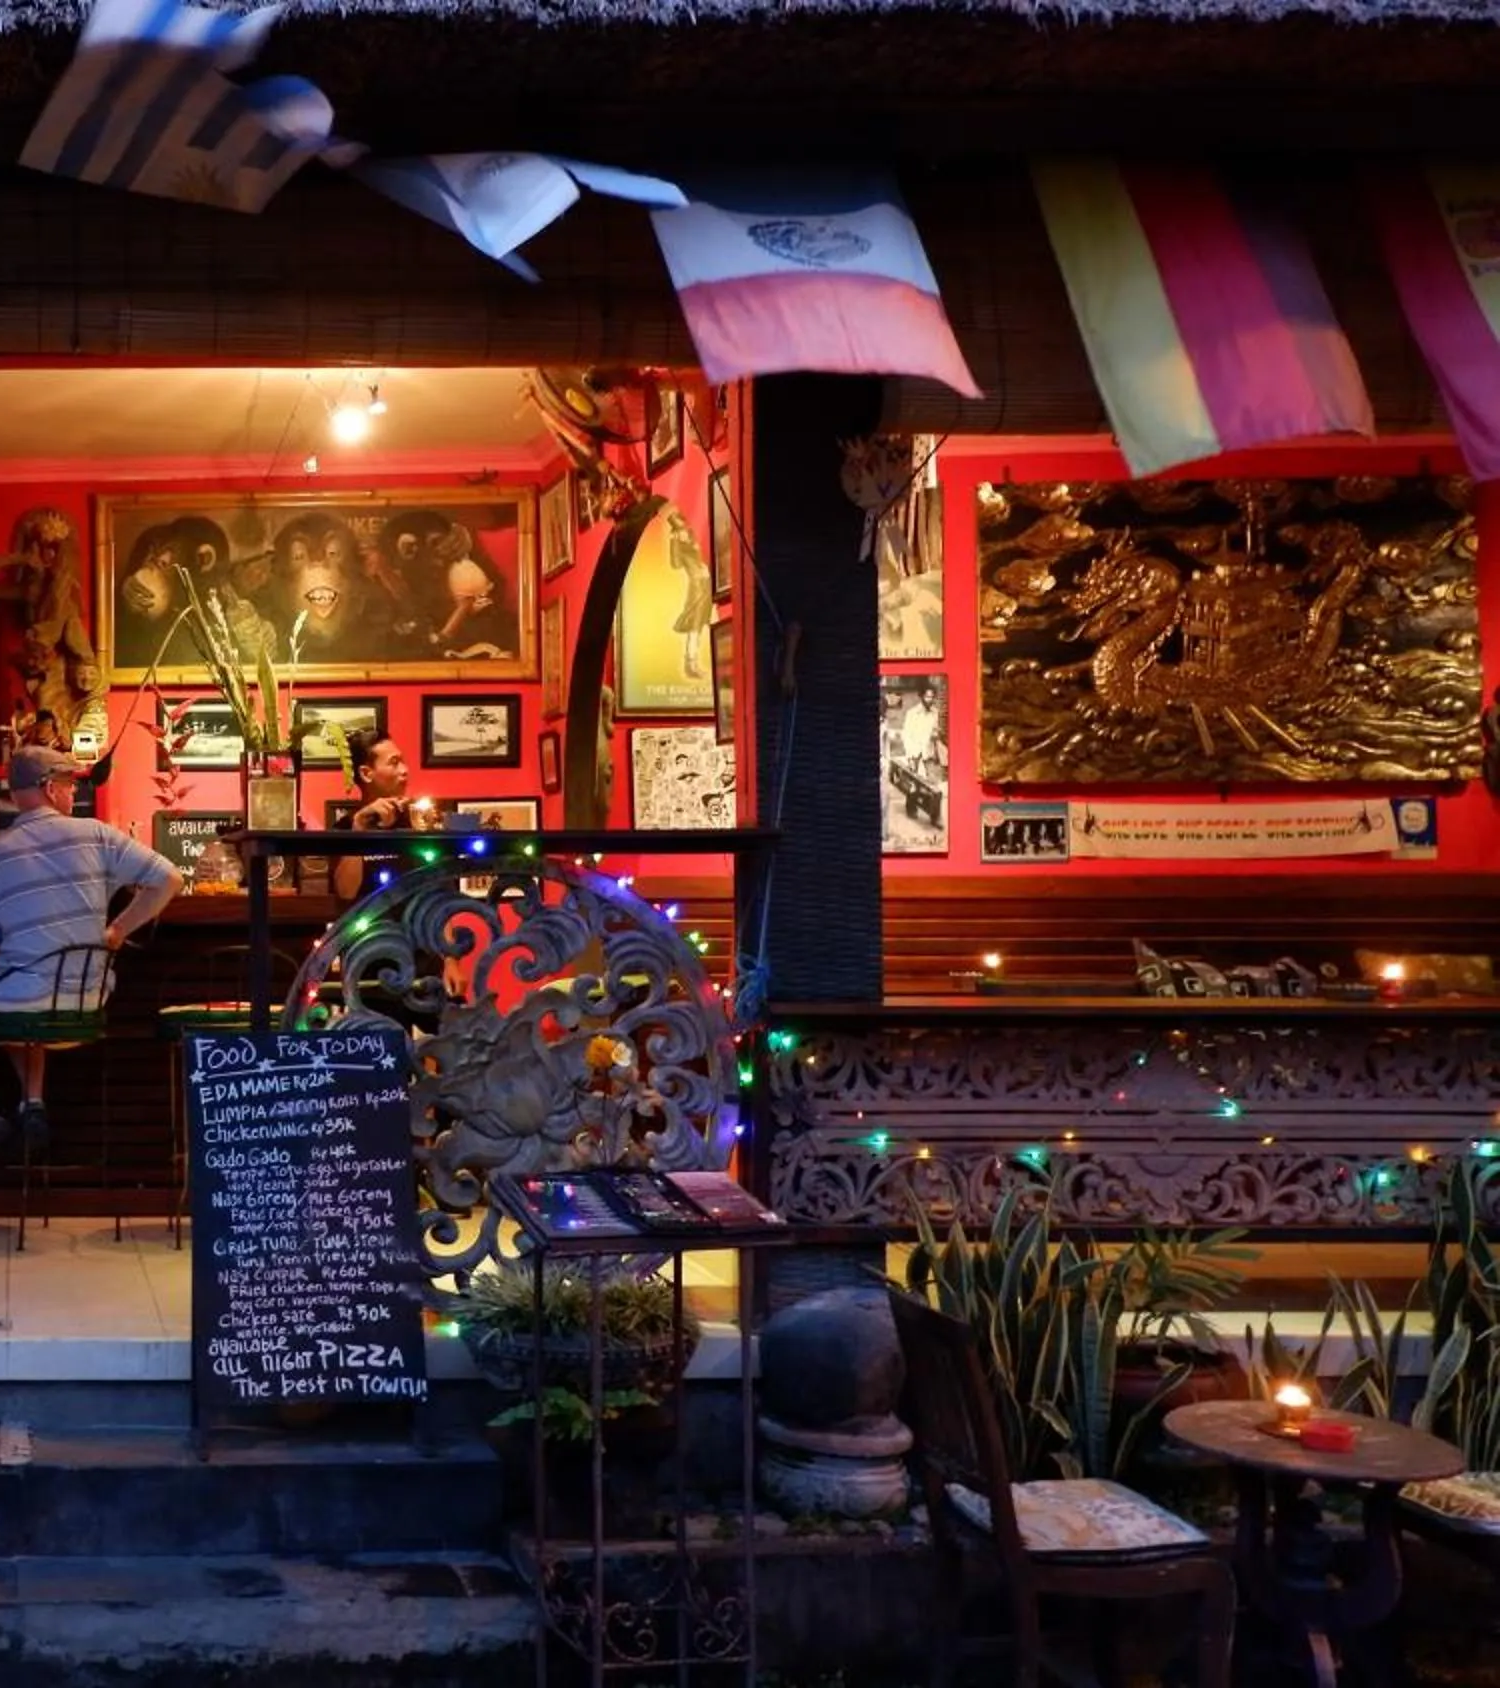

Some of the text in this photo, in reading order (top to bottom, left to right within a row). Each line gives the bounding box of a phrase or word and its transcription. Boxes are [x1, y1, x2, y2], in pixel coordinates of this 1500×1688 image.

[277, 1035, 315, 1057] FOR
[317, 1036, 386, 1060] TODAY
[203, 1104, 267, 1126] LUMPIA
[205, 1147, 245, 1169] Gado
[248, 1146, 291, 1167] Gado
[315, 1340, 405, 1370] PIZZA
[231, 1376, 273, 1398] The
[281, 1373, 328, 1397] best
[335, 1376, 354, 1393] in
